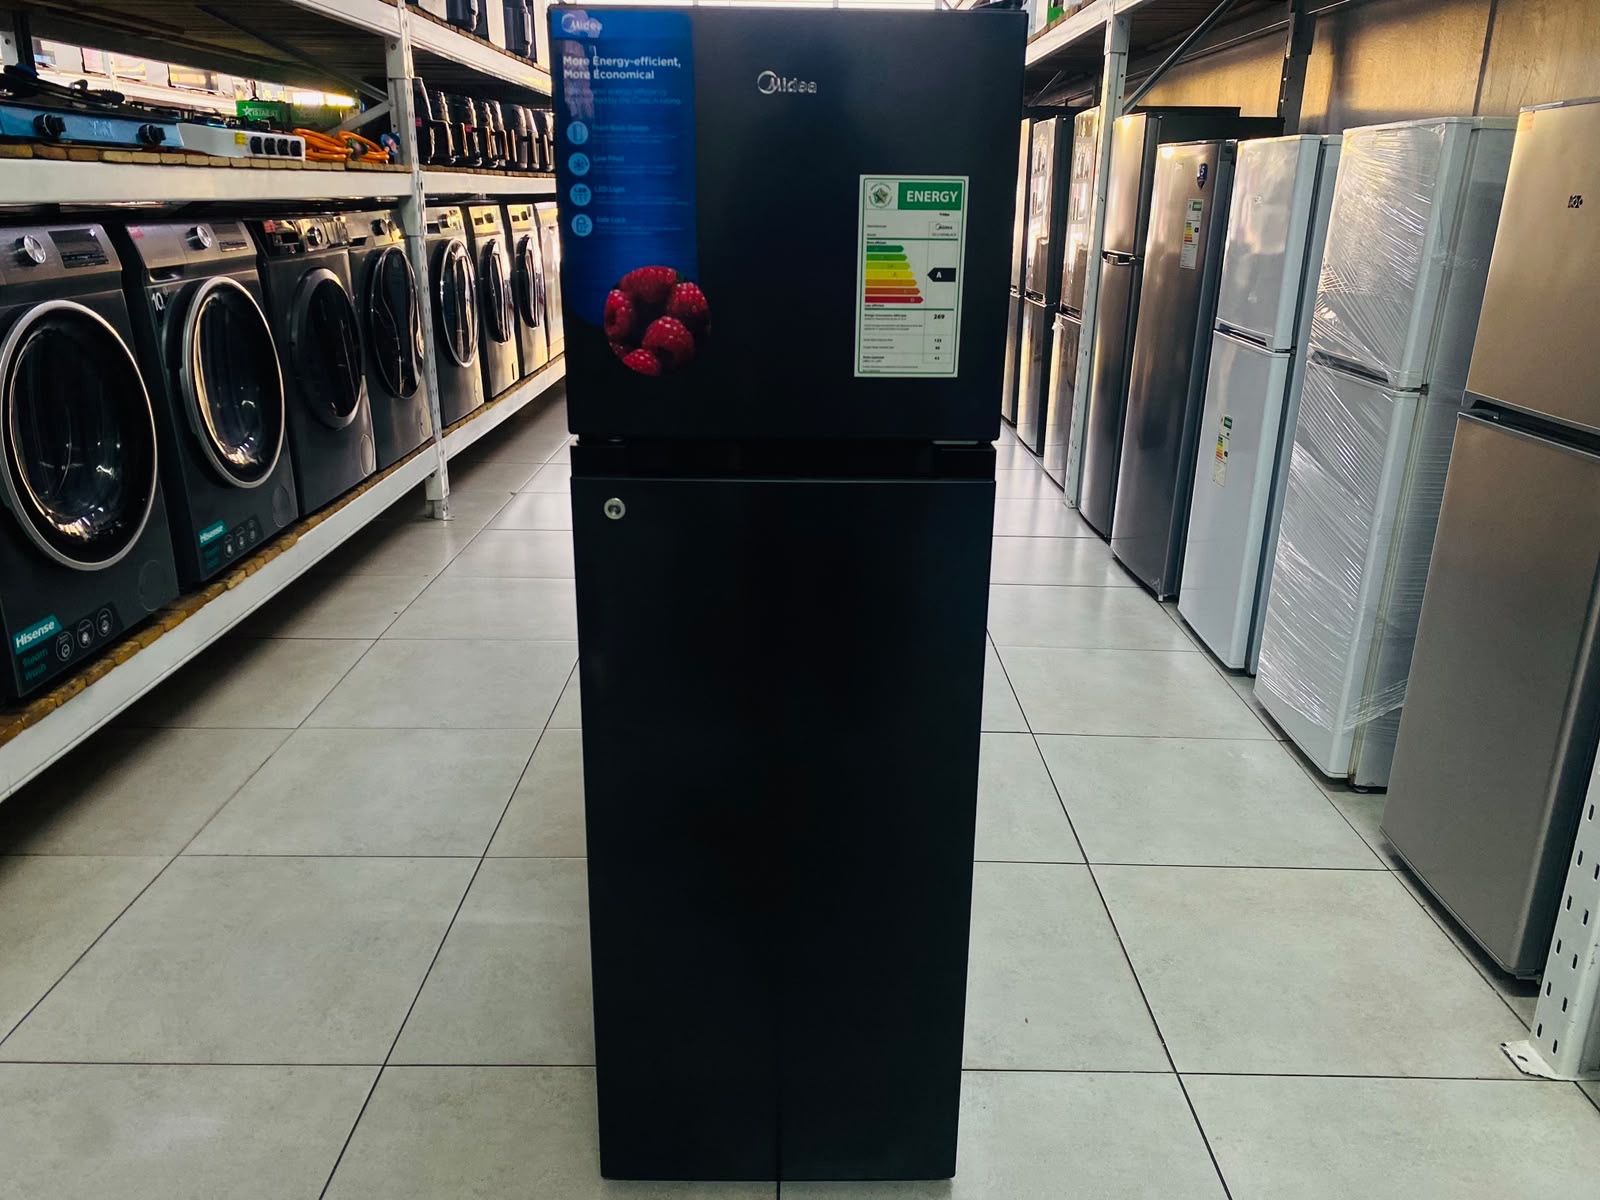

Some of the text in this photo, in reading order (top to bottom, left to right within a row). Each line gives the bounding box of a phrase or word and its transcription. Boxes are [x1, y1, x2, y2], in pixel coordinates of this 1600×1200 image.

[563, 55, 682, 69] More Energy-efficient,
[563, 69, 655, 80] More Economical
[757, 70, 817, 94] Midea
[906, 190, 959, 203] ENERGY
[936, 271, 942, 279] A
[15, 621, 55, 648] Hisense
